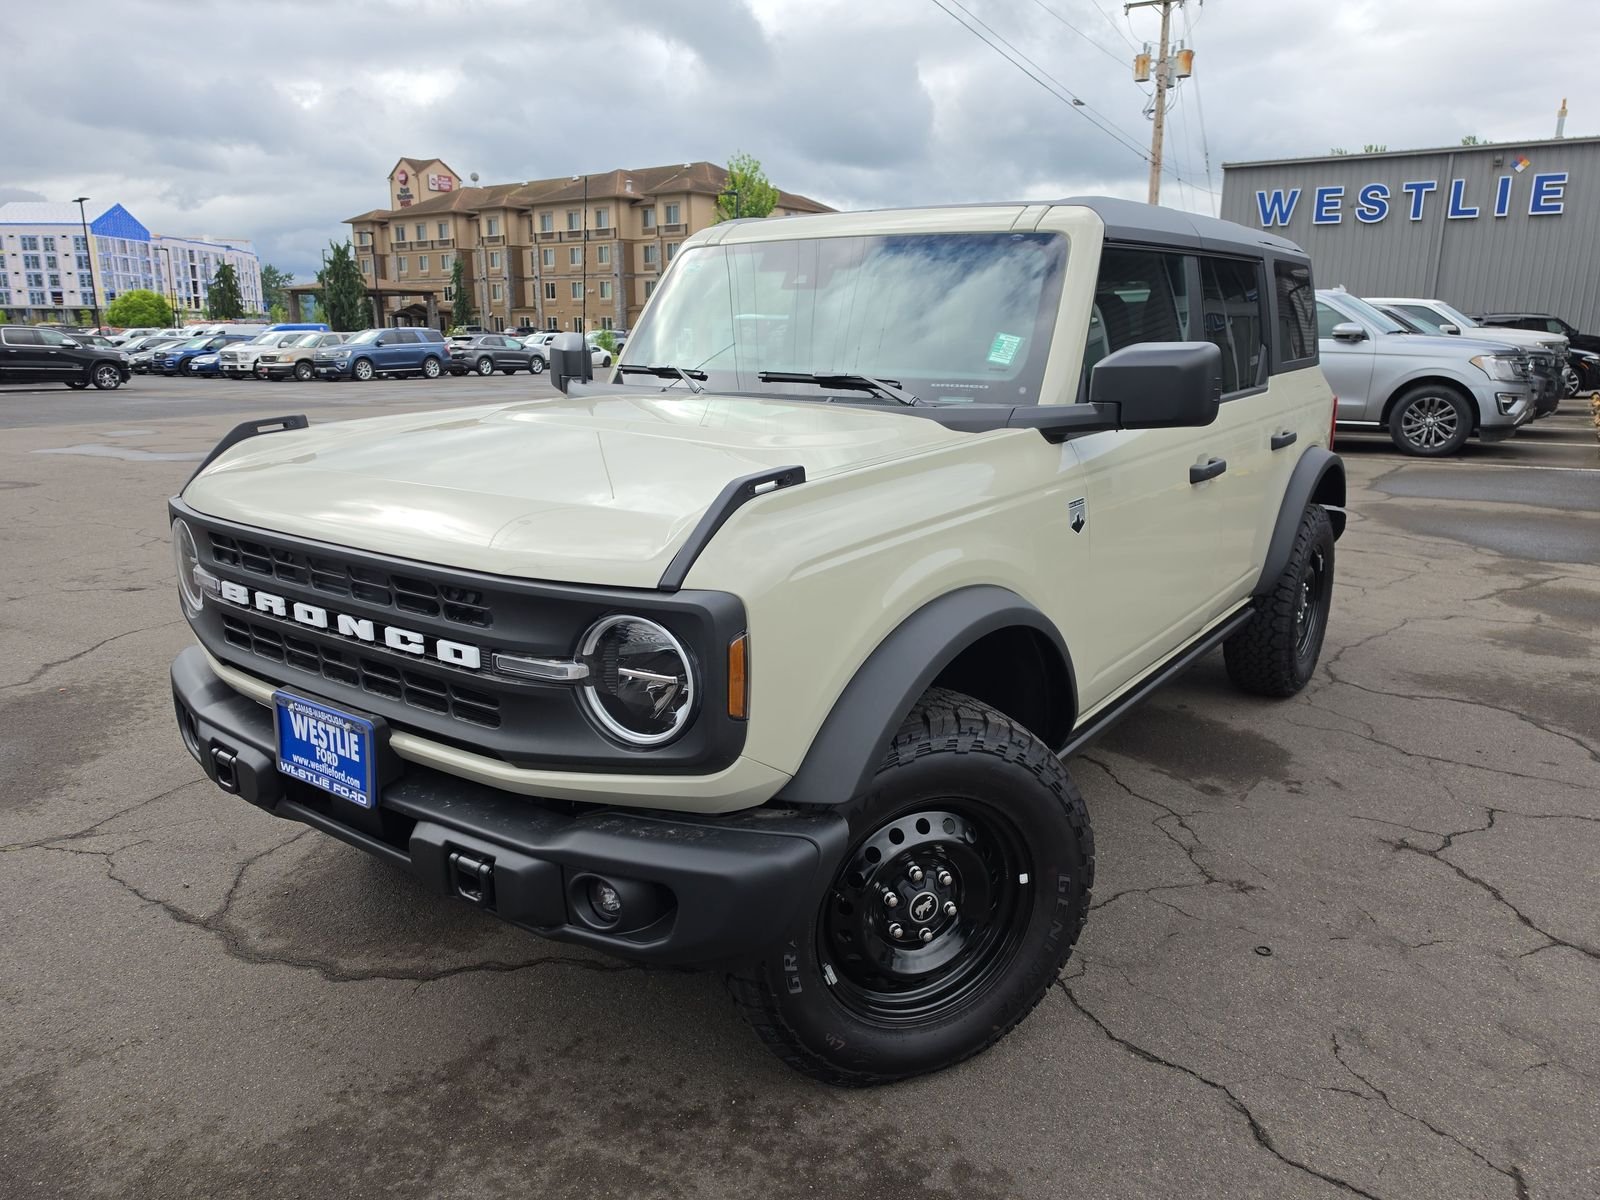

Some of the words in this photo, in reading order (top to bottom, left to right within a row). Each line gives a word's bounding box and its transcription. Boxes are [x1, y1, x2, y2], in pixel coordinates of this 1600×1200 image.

[1256, 171, 1569, 227] WESTLIE
[221, 580, 481, 670] BRONCO
[289, 710, 360, 762] WESTLIE
[316, 746, 338, 767] FORD
[280, 761, 330, 789] WESTLIE
[333, 783, 367, 804] FORD
[292, 754, 360, 788] www.westlieford.com
